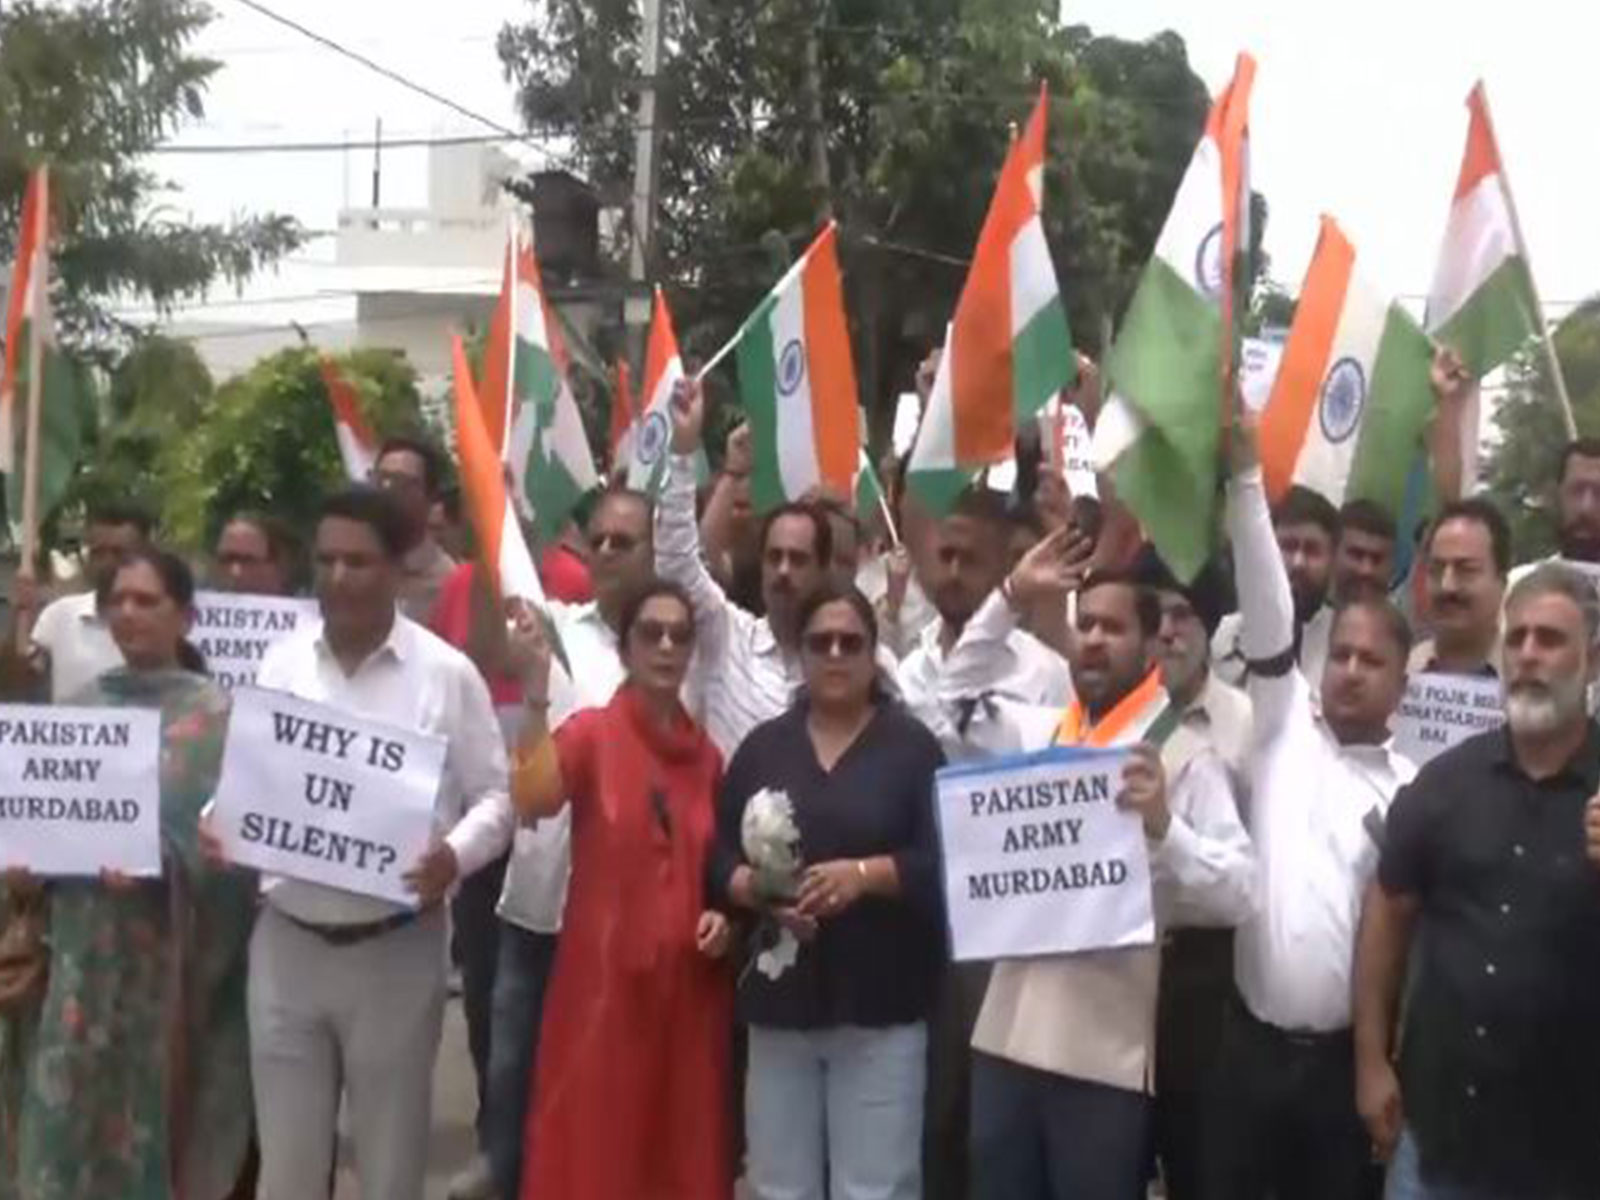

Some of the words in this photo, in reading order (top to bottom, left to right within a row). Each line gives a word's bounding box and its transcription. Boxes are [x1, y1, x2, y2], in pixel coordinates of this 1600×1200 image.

[197, 607, 297, 631] KISTAN
[200, 638, 268, 660] ARMY
[0, 720, 129, 747] PAKISTAN
[273, 712, 357, 758] WHY
[367, 737, 405, 772] IS
[22, 757, 102, 781] ARMY
[304, 773, 354, 812] UN
[969, 775, 1109, 816] PAKISTAN
[240, 812, 397, 874] SILENT?
[1003, 819, 1083, 852] ARMY
[967, 859, 1127, 899] MURDABAD
